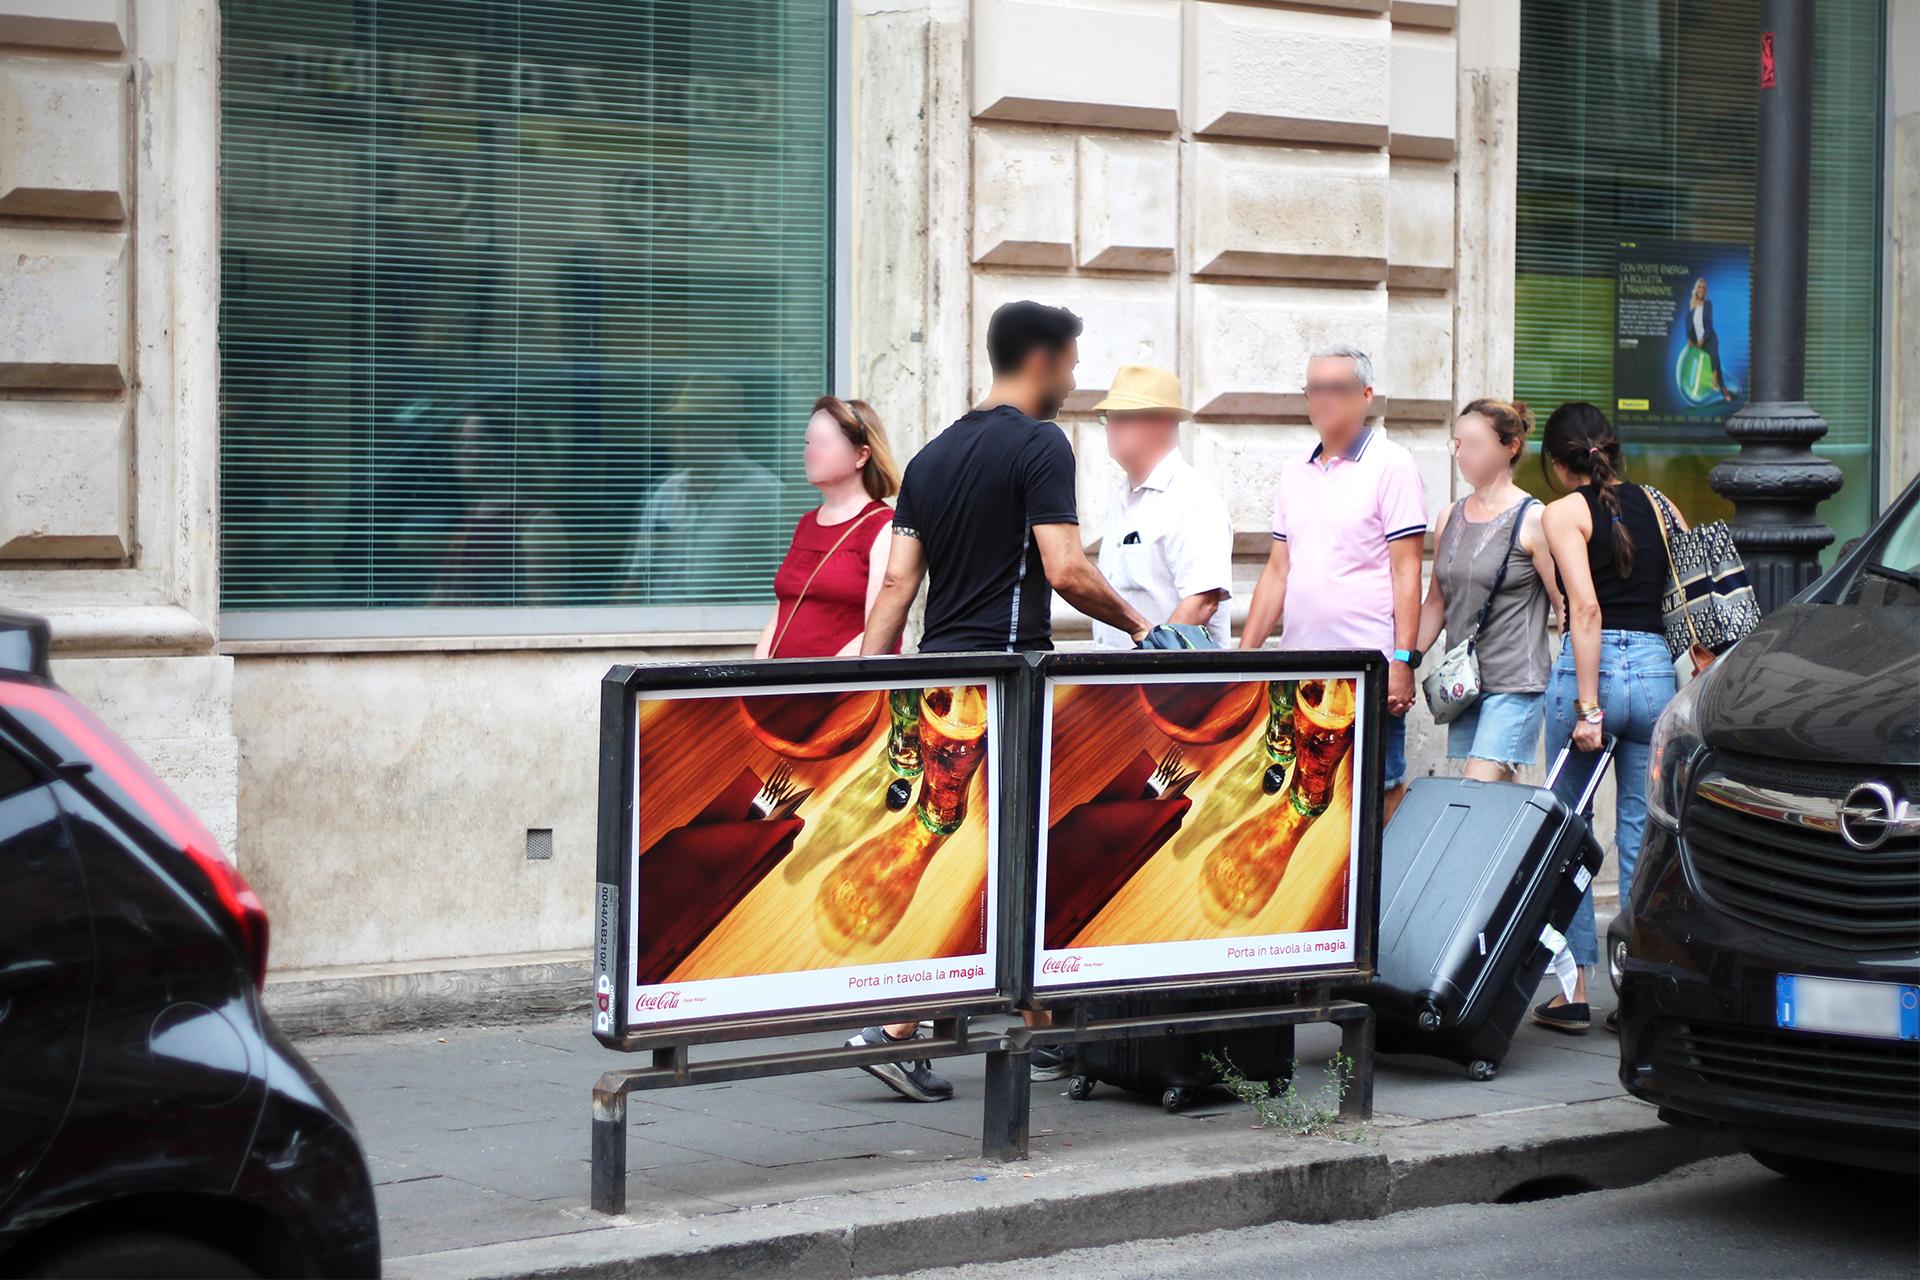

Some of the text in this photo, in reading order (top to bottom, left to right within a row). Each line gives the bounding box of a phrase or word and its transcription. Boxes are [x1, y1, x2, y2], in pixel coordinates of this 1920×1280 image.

[600, 887, 608, 971] 0044/AB210/P
[1227, 947, 1255, 958] Porta
[1258, 945, 1267, 956] in
[1270, 943, 1300, 955] tavola
[1303, 942, 1312, 952] la
[848, 976, 880, 988] Porta
[883, 974, 893, 985] in
[897, 970, 932, 984] tavola
[935, 969, 945, 980] la
[597, 974, 610, 1031] apa
